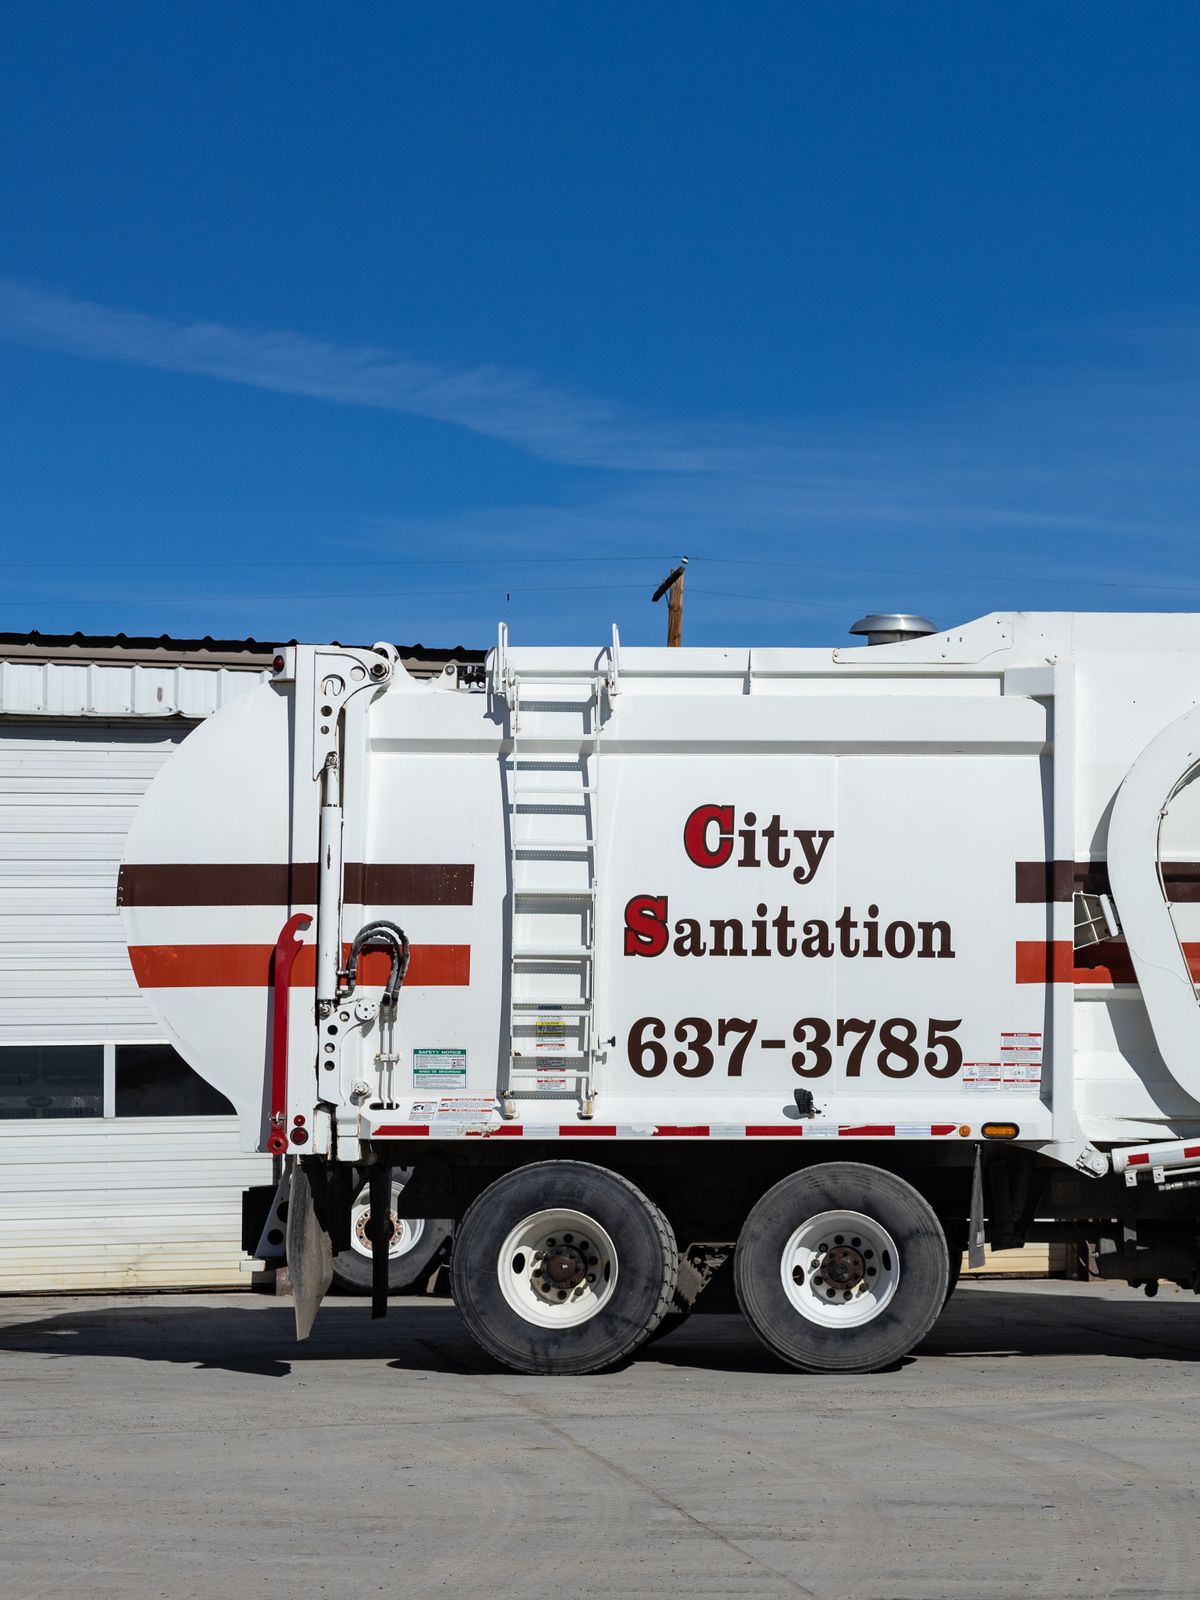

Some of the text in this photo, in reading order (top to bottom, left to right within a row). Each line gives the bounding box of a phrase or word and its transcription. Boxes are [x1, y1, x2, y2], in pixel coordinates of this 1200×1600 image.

[684, 804, 834, 885] City
[624, 894, 955, 958] Sanitation
[628, 1017, 963, 1078] 637-3785
